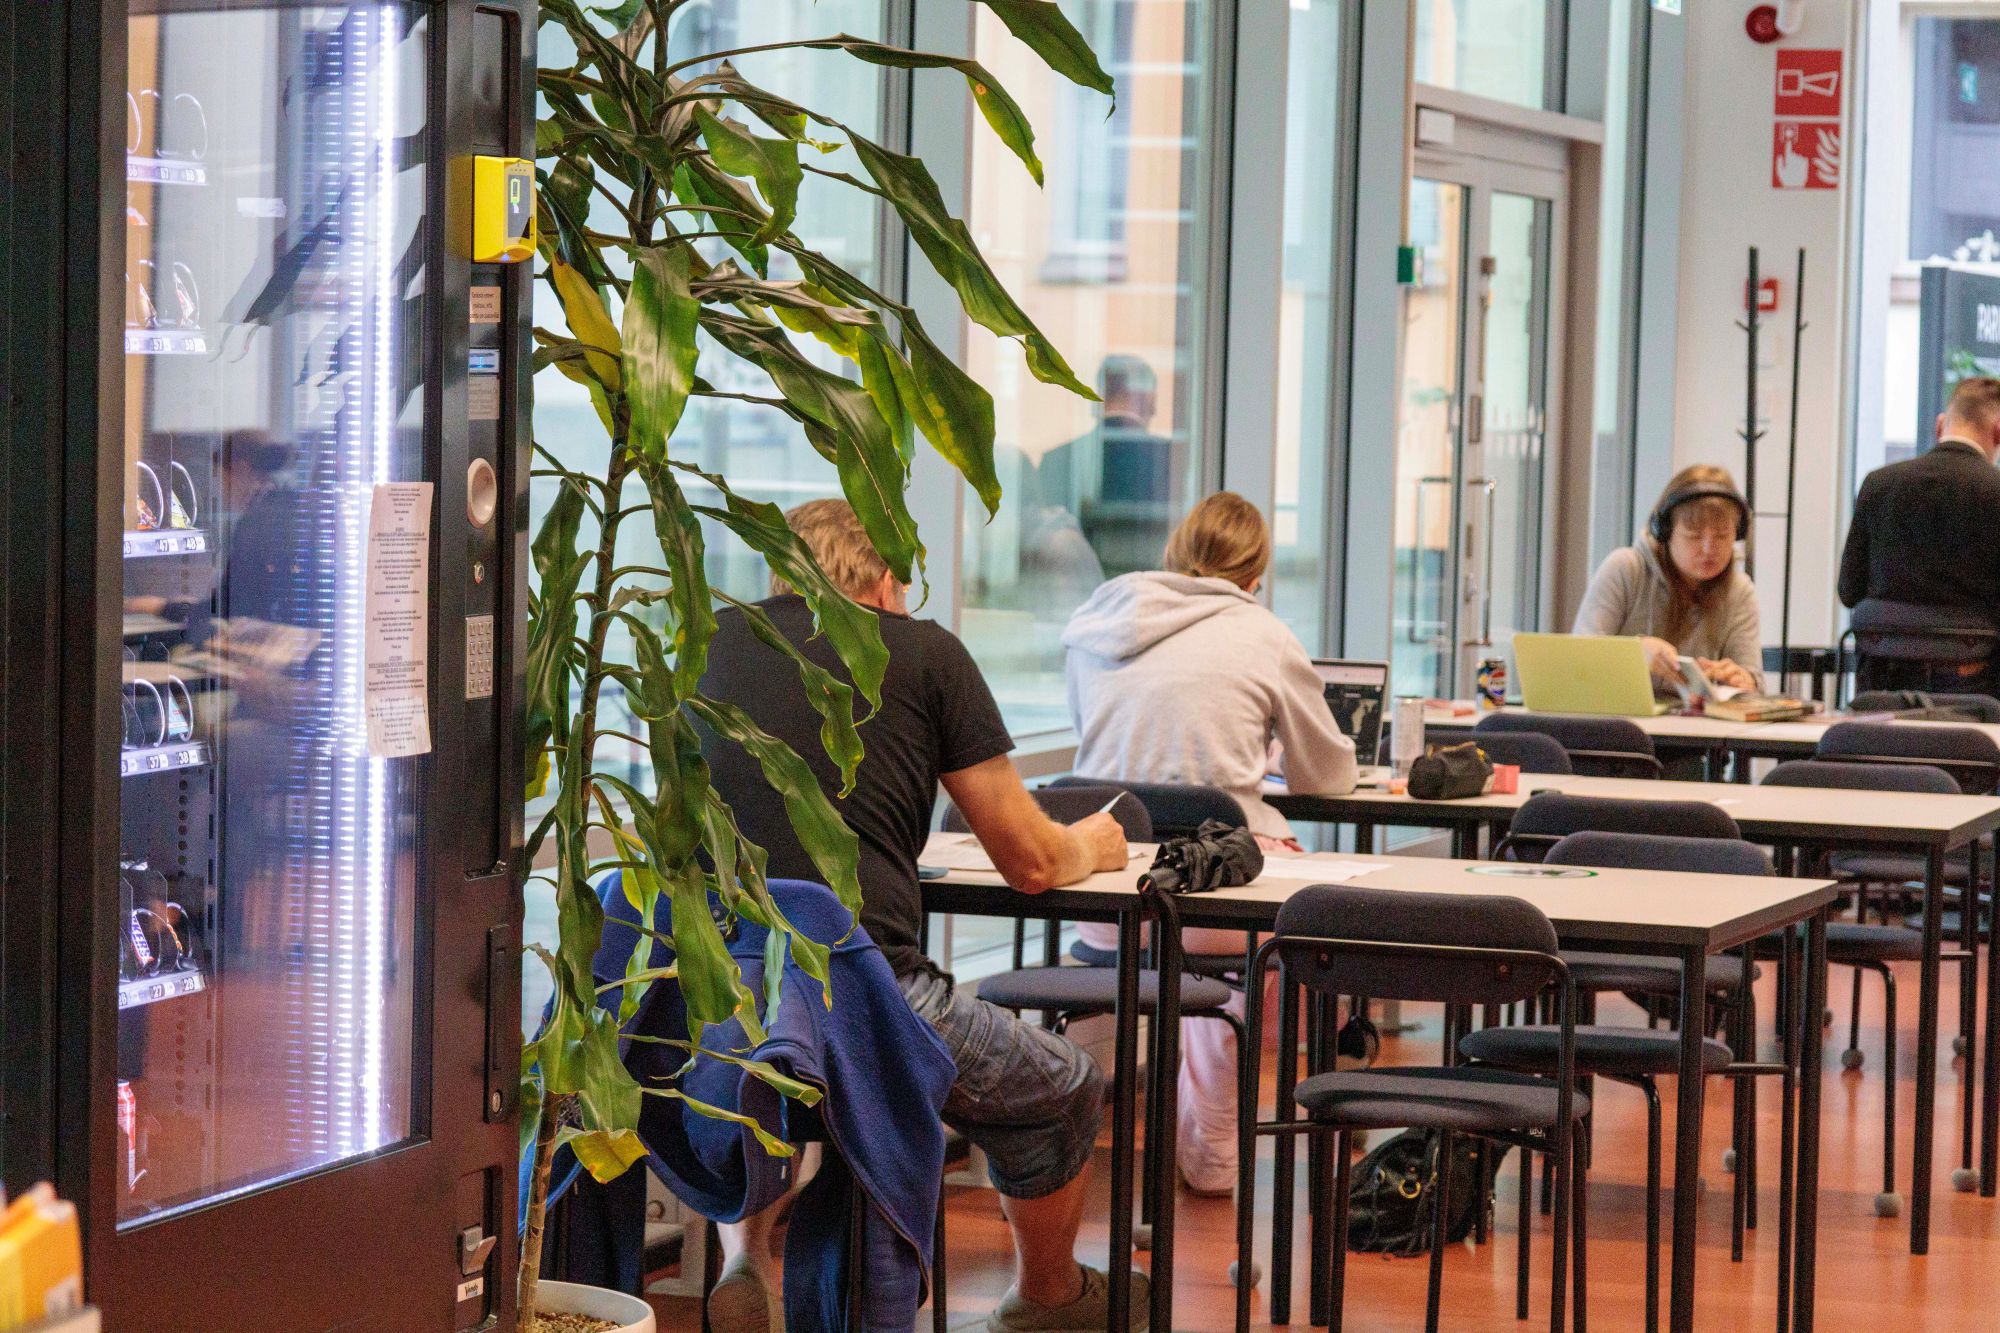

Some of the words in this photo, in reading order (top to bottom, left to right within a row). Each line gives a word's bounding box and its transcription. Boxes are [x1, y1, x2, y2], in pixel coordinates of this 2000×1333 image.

[1976, 303, 2000, 343] PAR
[149, 755, 160, 769] 37
[183, 978, 194, 991] 28
[152, 985, 163, 998] 27
